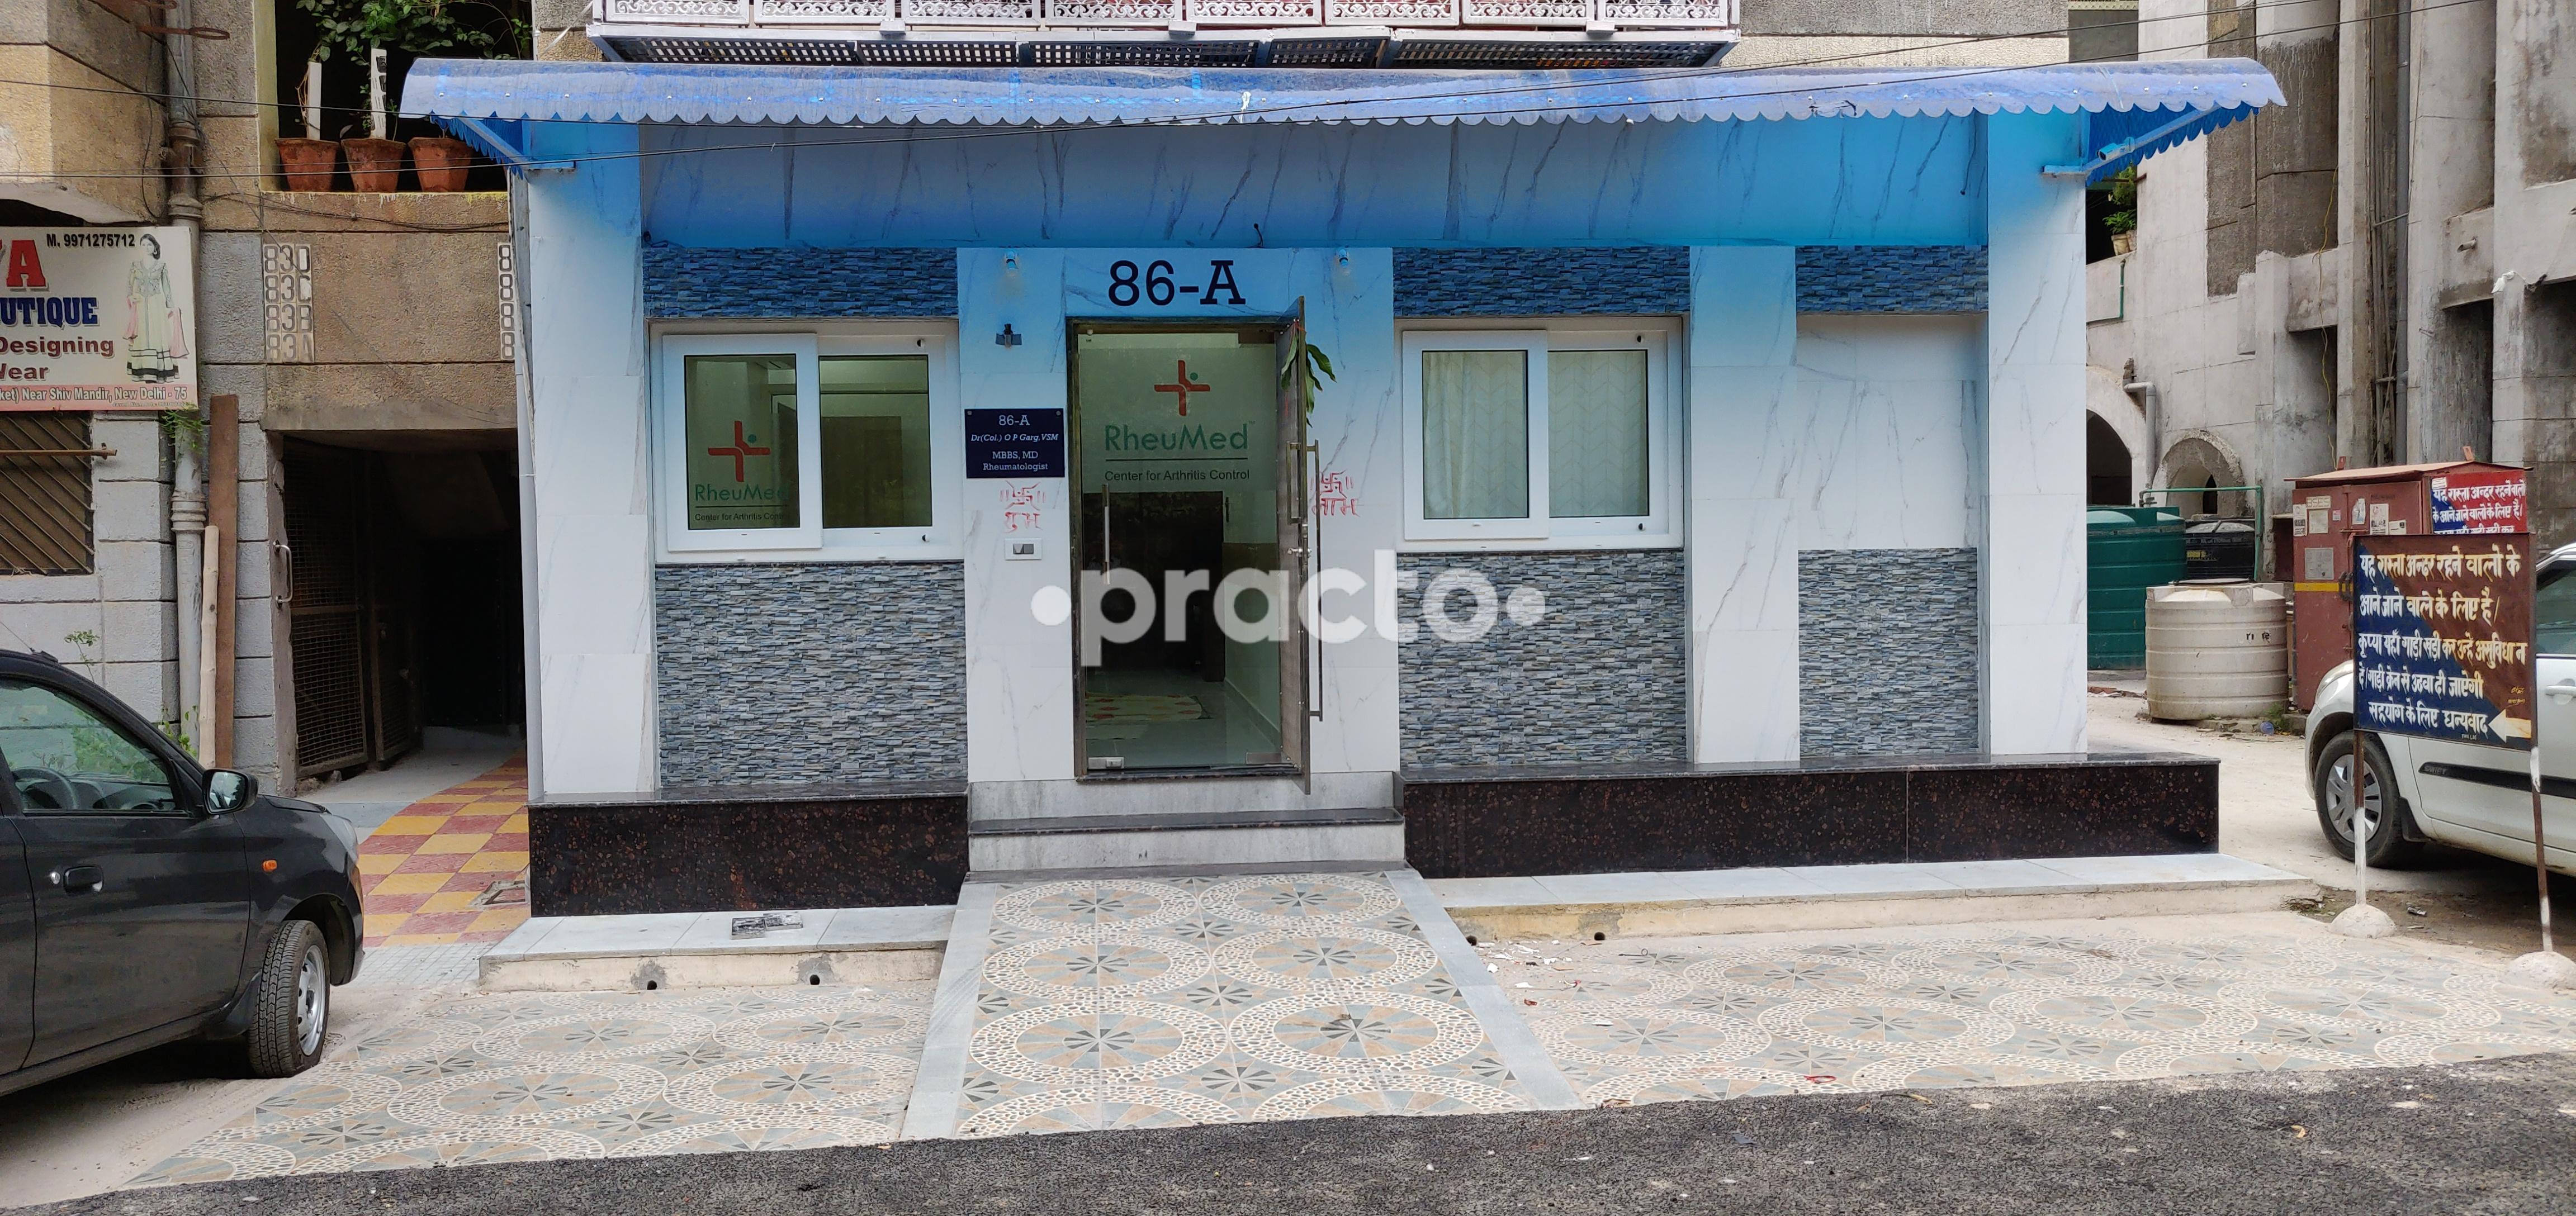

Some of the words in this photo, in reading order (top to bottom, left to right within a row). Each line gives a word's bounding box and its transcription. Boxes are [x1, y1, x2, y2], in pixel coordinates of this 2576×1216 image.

[47, 234, 60, 246] M.
[64, 234, 135, 247] 9971275712
[1108, 260, 1246, 306] 86-A
[22, 388, 46, 400] Near
[50, 387, 72, 400] Shiv
[74, 387, 112, 403] Mandir,
[115, 387, 138, 400] New
[141, 387, 166, 400] Delhi
[174, 387, 187, 400] 75
[999, 415, 1030, 426] 86-A
[970, 434, 1002, 443] Dr(Col.)
[1105, 423, 1248, 451] RheuMed
[992, 451, 1021, 460] MBBS,
[983, 463, 1048, 472] Rheumatologist
[1105, 471, 1143, 481] Center
[1146, 470, 1161, 481] for
[1163, 469, 1206, 481] Arthritis
[1209, 469, 1249, 480] Control
[695, 483, 790, 501] RheuMed
[2359, 554, 2375, 583] यह
[2376, 553, 2406, 580] रास्ता
[2405, 554, 2436, 581] अन्दर
[2436, 545, 2464, 582] रहने
[2506, 544, 2521, 579] के
[2360, 586, 2381, 616] आने
[2381, 586, 2404, 618] जाने
[2406, 590, 2435, 620] वाले
[2435, 588, 2449, 620] के
[2450, 591, 2480, 621] लिए
[2442, 638, 2457, 661] कर
[2401, 666, 2411, 694] से
[2368, 695, 2404, 728] सहयोग
[2405, 697, 2416, 725] के
[2416, 700, 2440, 730] लिए
